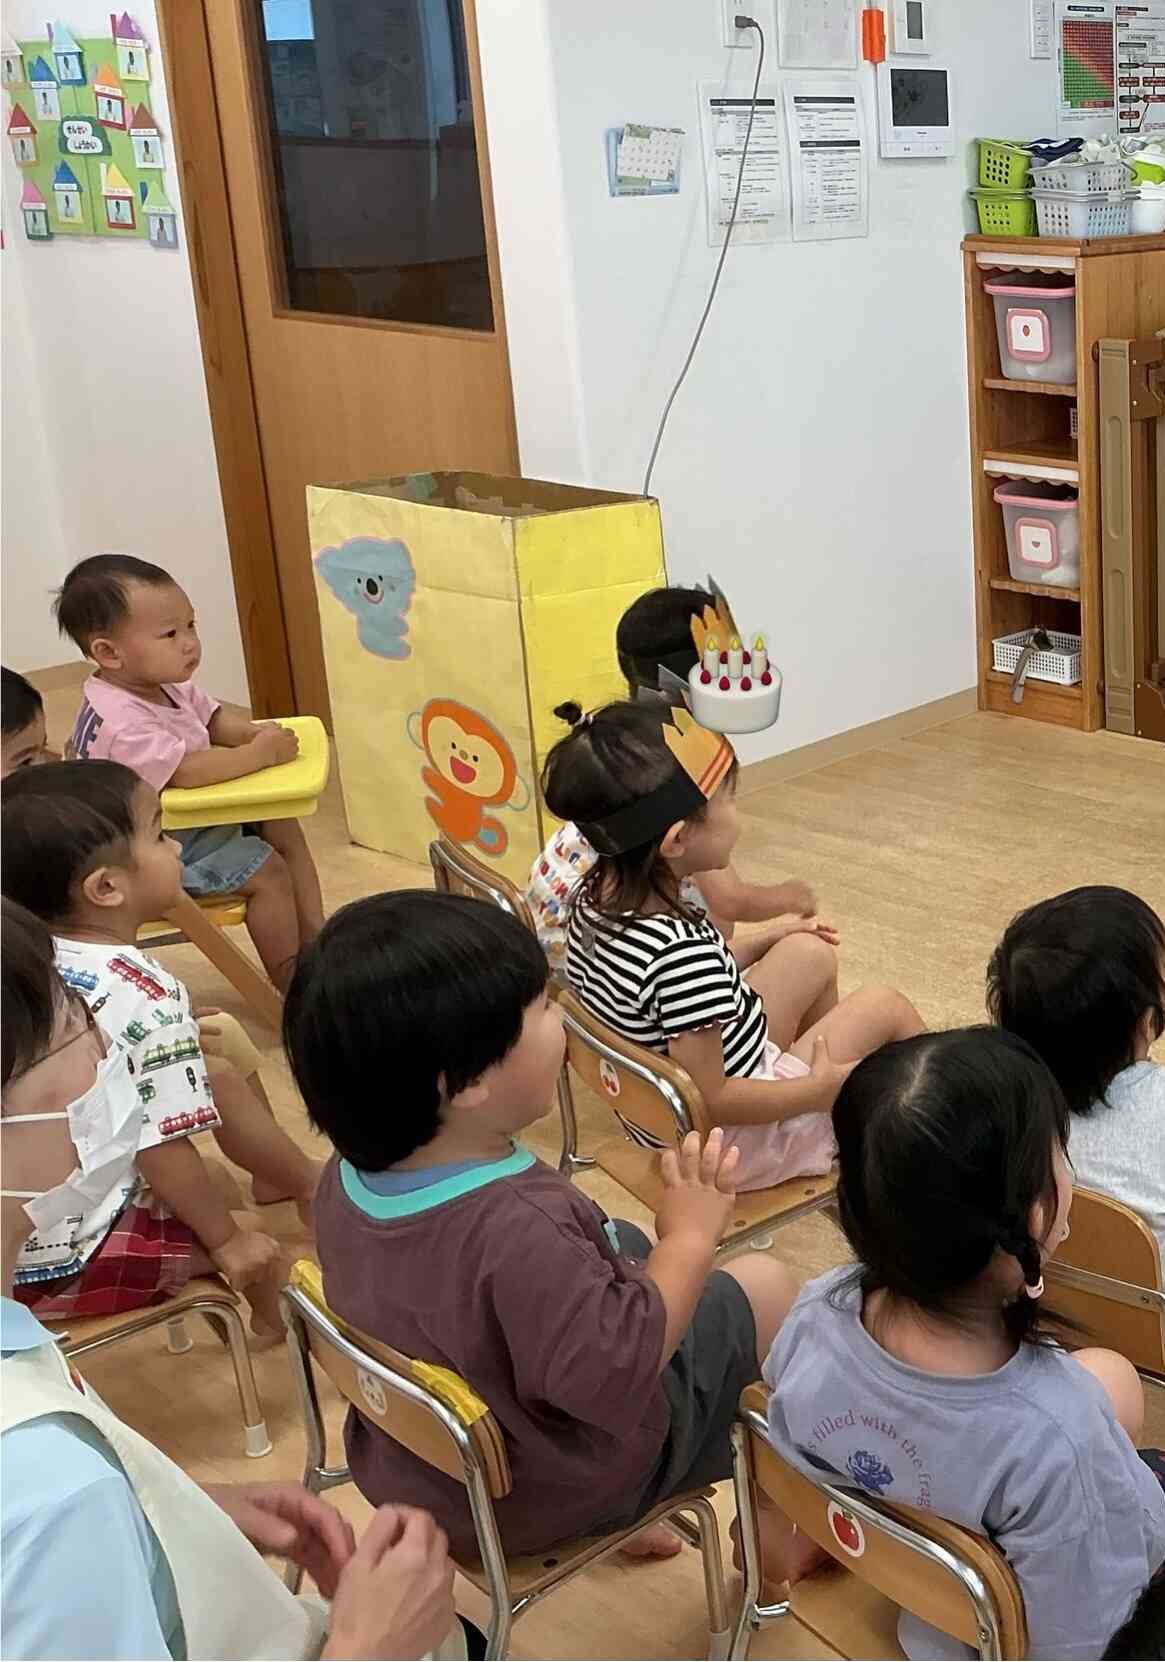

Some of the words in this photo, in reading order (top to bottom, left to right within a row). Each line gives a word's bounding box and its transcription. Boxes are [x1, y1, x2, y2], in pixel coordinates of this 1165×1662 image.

[812, 1408, 857, 1442] filled
[861, 1414, 897, 1440] with
[901, 1439, 923, 1468] the
